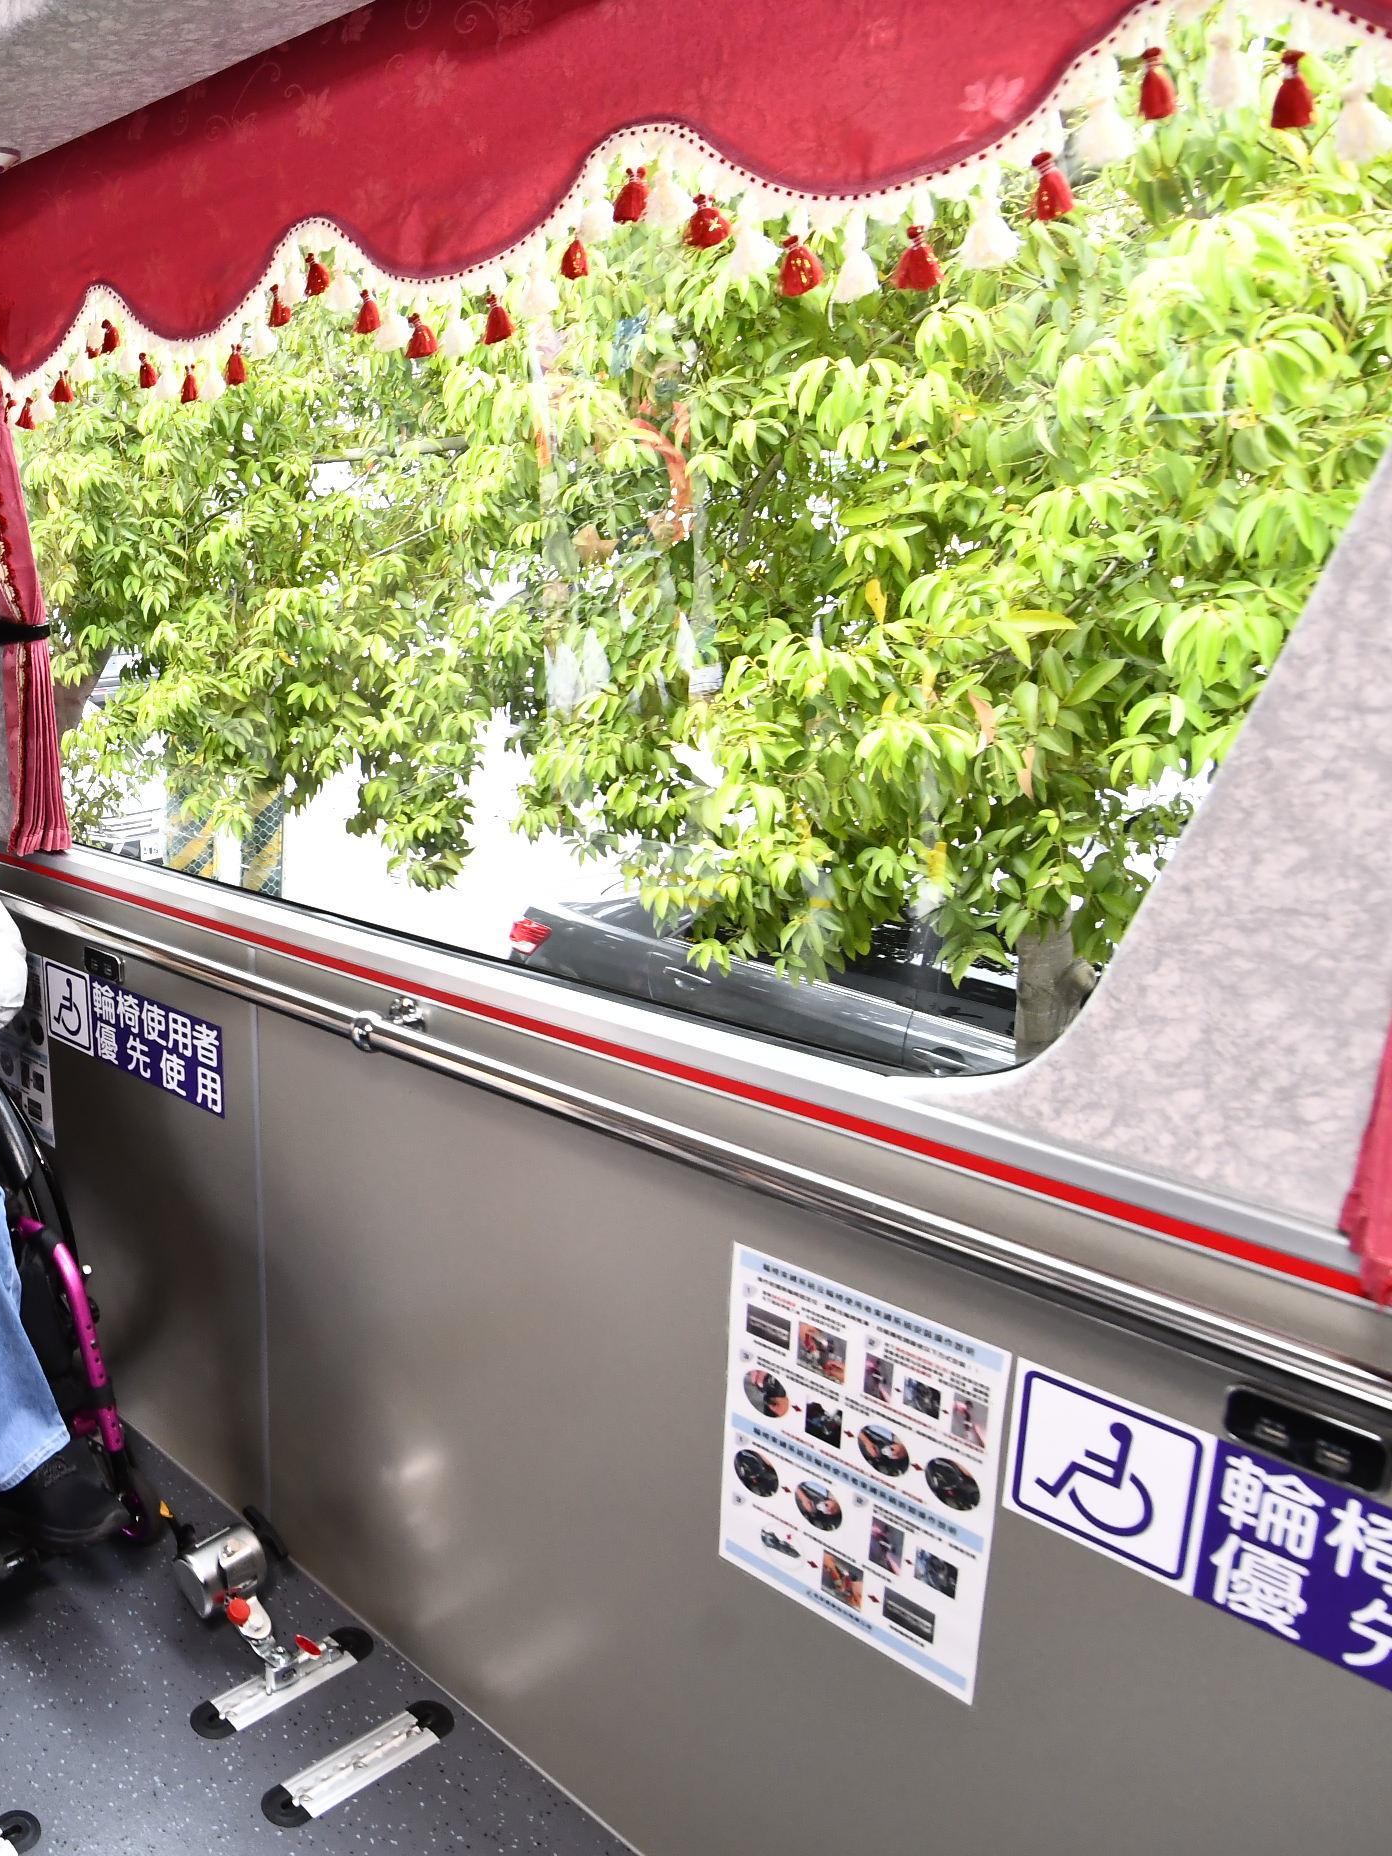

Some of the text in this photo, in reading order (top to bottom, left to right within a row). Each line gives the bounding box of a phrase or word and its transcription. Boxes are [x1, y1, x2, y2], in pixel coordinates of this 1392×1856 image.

[91, 980, 221, 1068] 輪椅使用者
[94, 1021, 223, 1115] 優先使用
